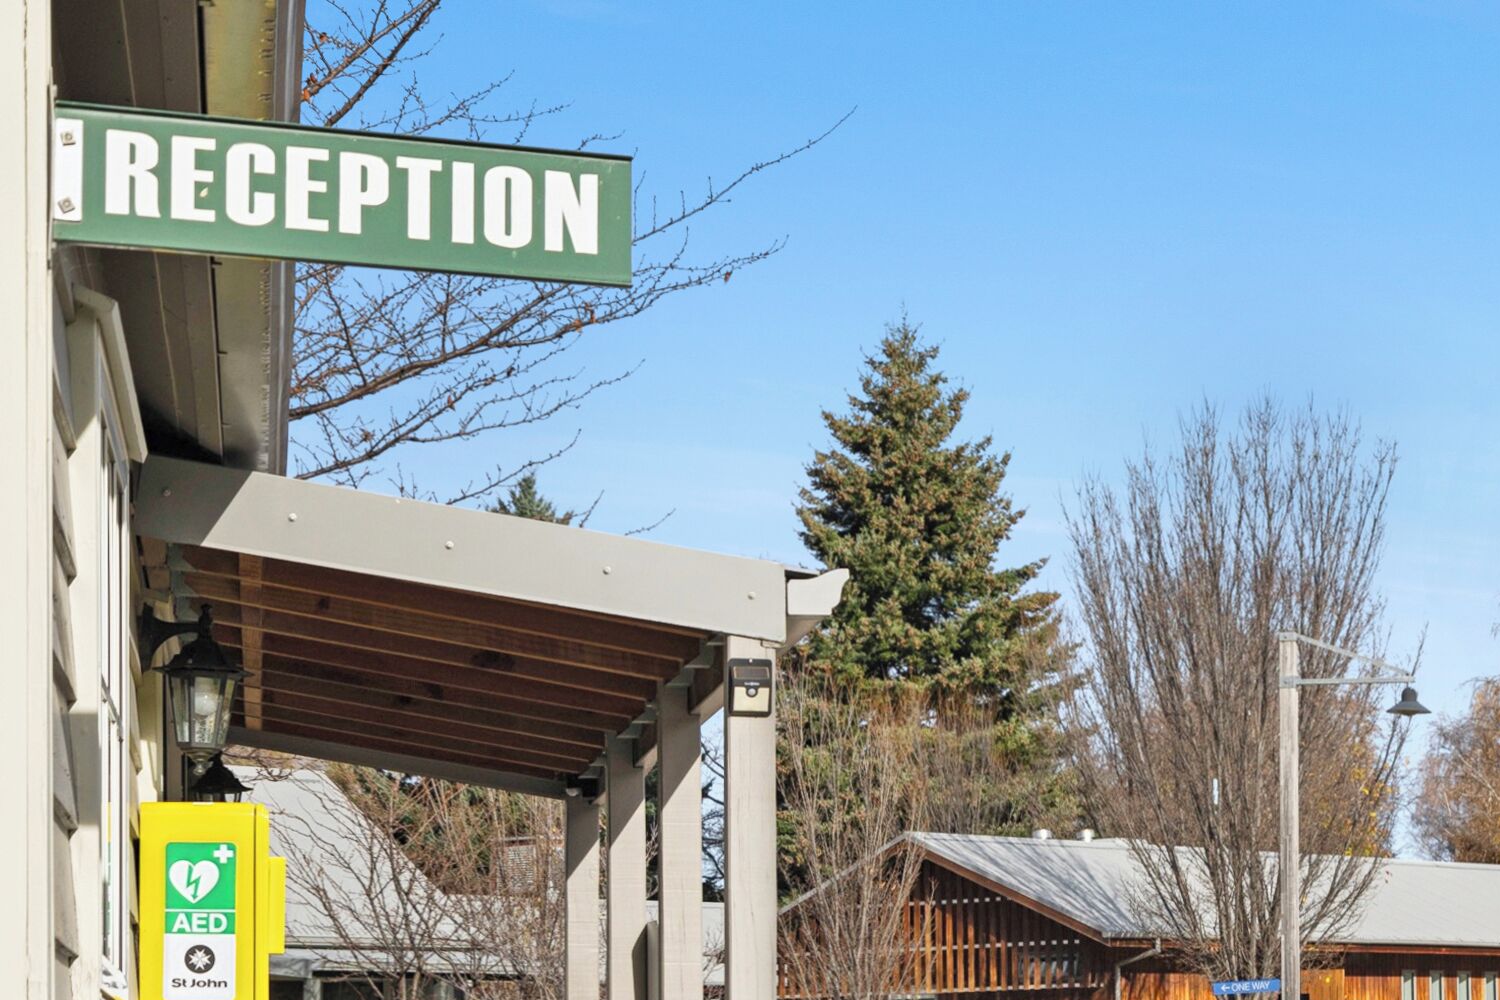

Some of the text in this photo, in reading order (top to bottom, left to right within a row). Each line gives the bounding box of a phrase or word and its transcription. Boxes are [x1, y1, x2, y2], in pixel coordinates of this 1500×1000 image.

[104, 128, 599, 255] RECEPTION
[171, 913, 228, 933] AED
[171, 978, 228, 988] St John
[1231, 980, 1270, 992] ONE WAY
